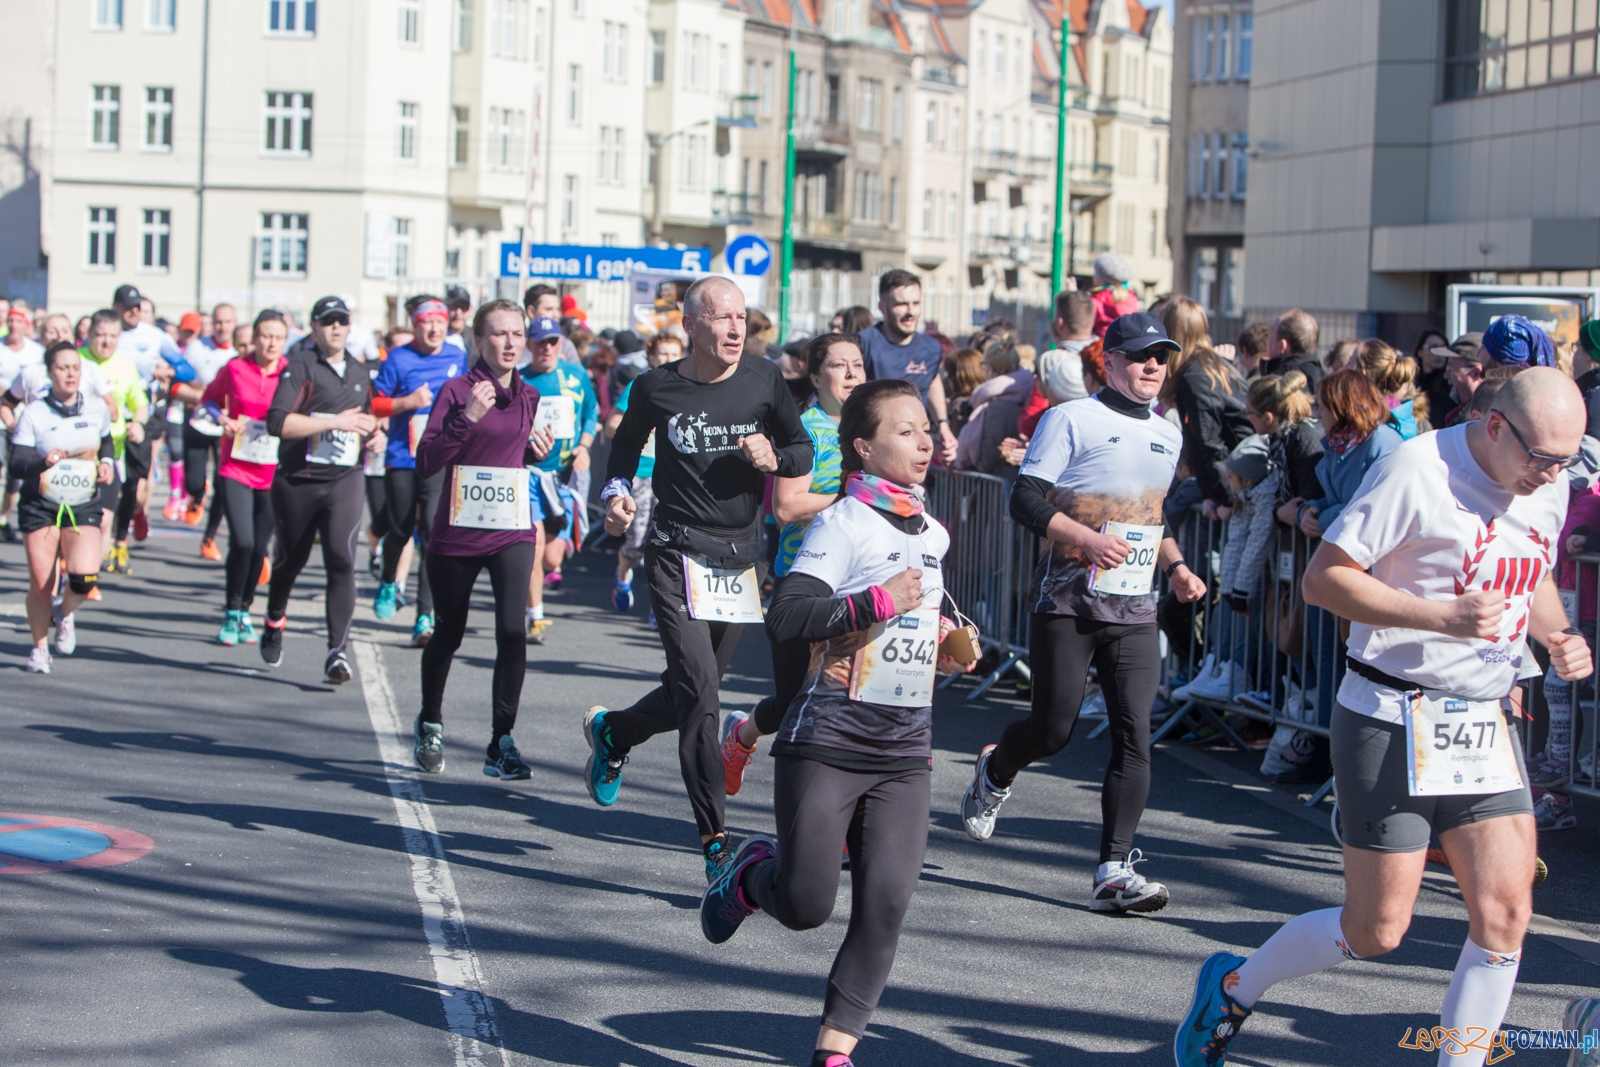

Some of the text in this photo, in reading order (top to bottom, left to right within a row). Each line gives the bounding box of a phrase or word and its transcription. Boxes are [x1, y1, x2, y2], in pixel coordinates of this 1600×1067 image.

[681, 251, 702, 272] 5
[703, 425, 728, 437] NOCNA
[51, 474, 90, 488] 4006
[461, 484, 516, 503] 10058
[1124, 547, 1155, 567] 002
[703, 573, 743, 595] 1716
[881, 637, 936, 666] 6342
[895, 668, 926, 678] Katarzyna
[1433, 721, 1497, 751] 5477
[1450, 754, 1489, 763] Remigiusz
